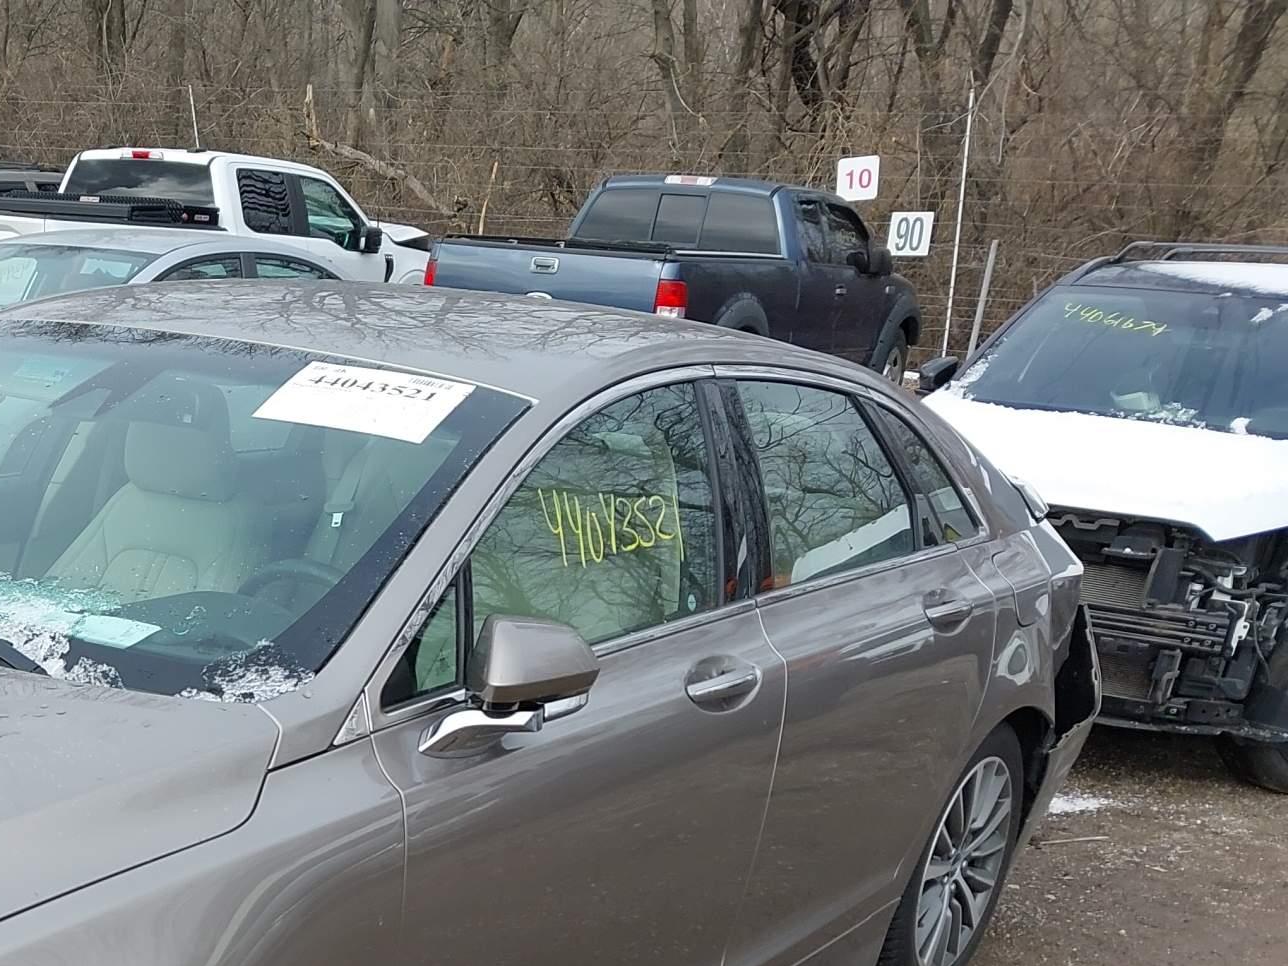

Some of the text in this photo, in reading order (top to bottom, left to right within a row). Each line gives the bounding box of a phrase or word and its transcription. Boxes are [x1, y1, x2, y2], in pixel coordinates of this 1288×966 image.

[845, 168, 872, 190] 10
[895, 216, 924, 251] 90
[309, 374, 438, 402] 44043521
[537, 488, 685, 569] 44043521
